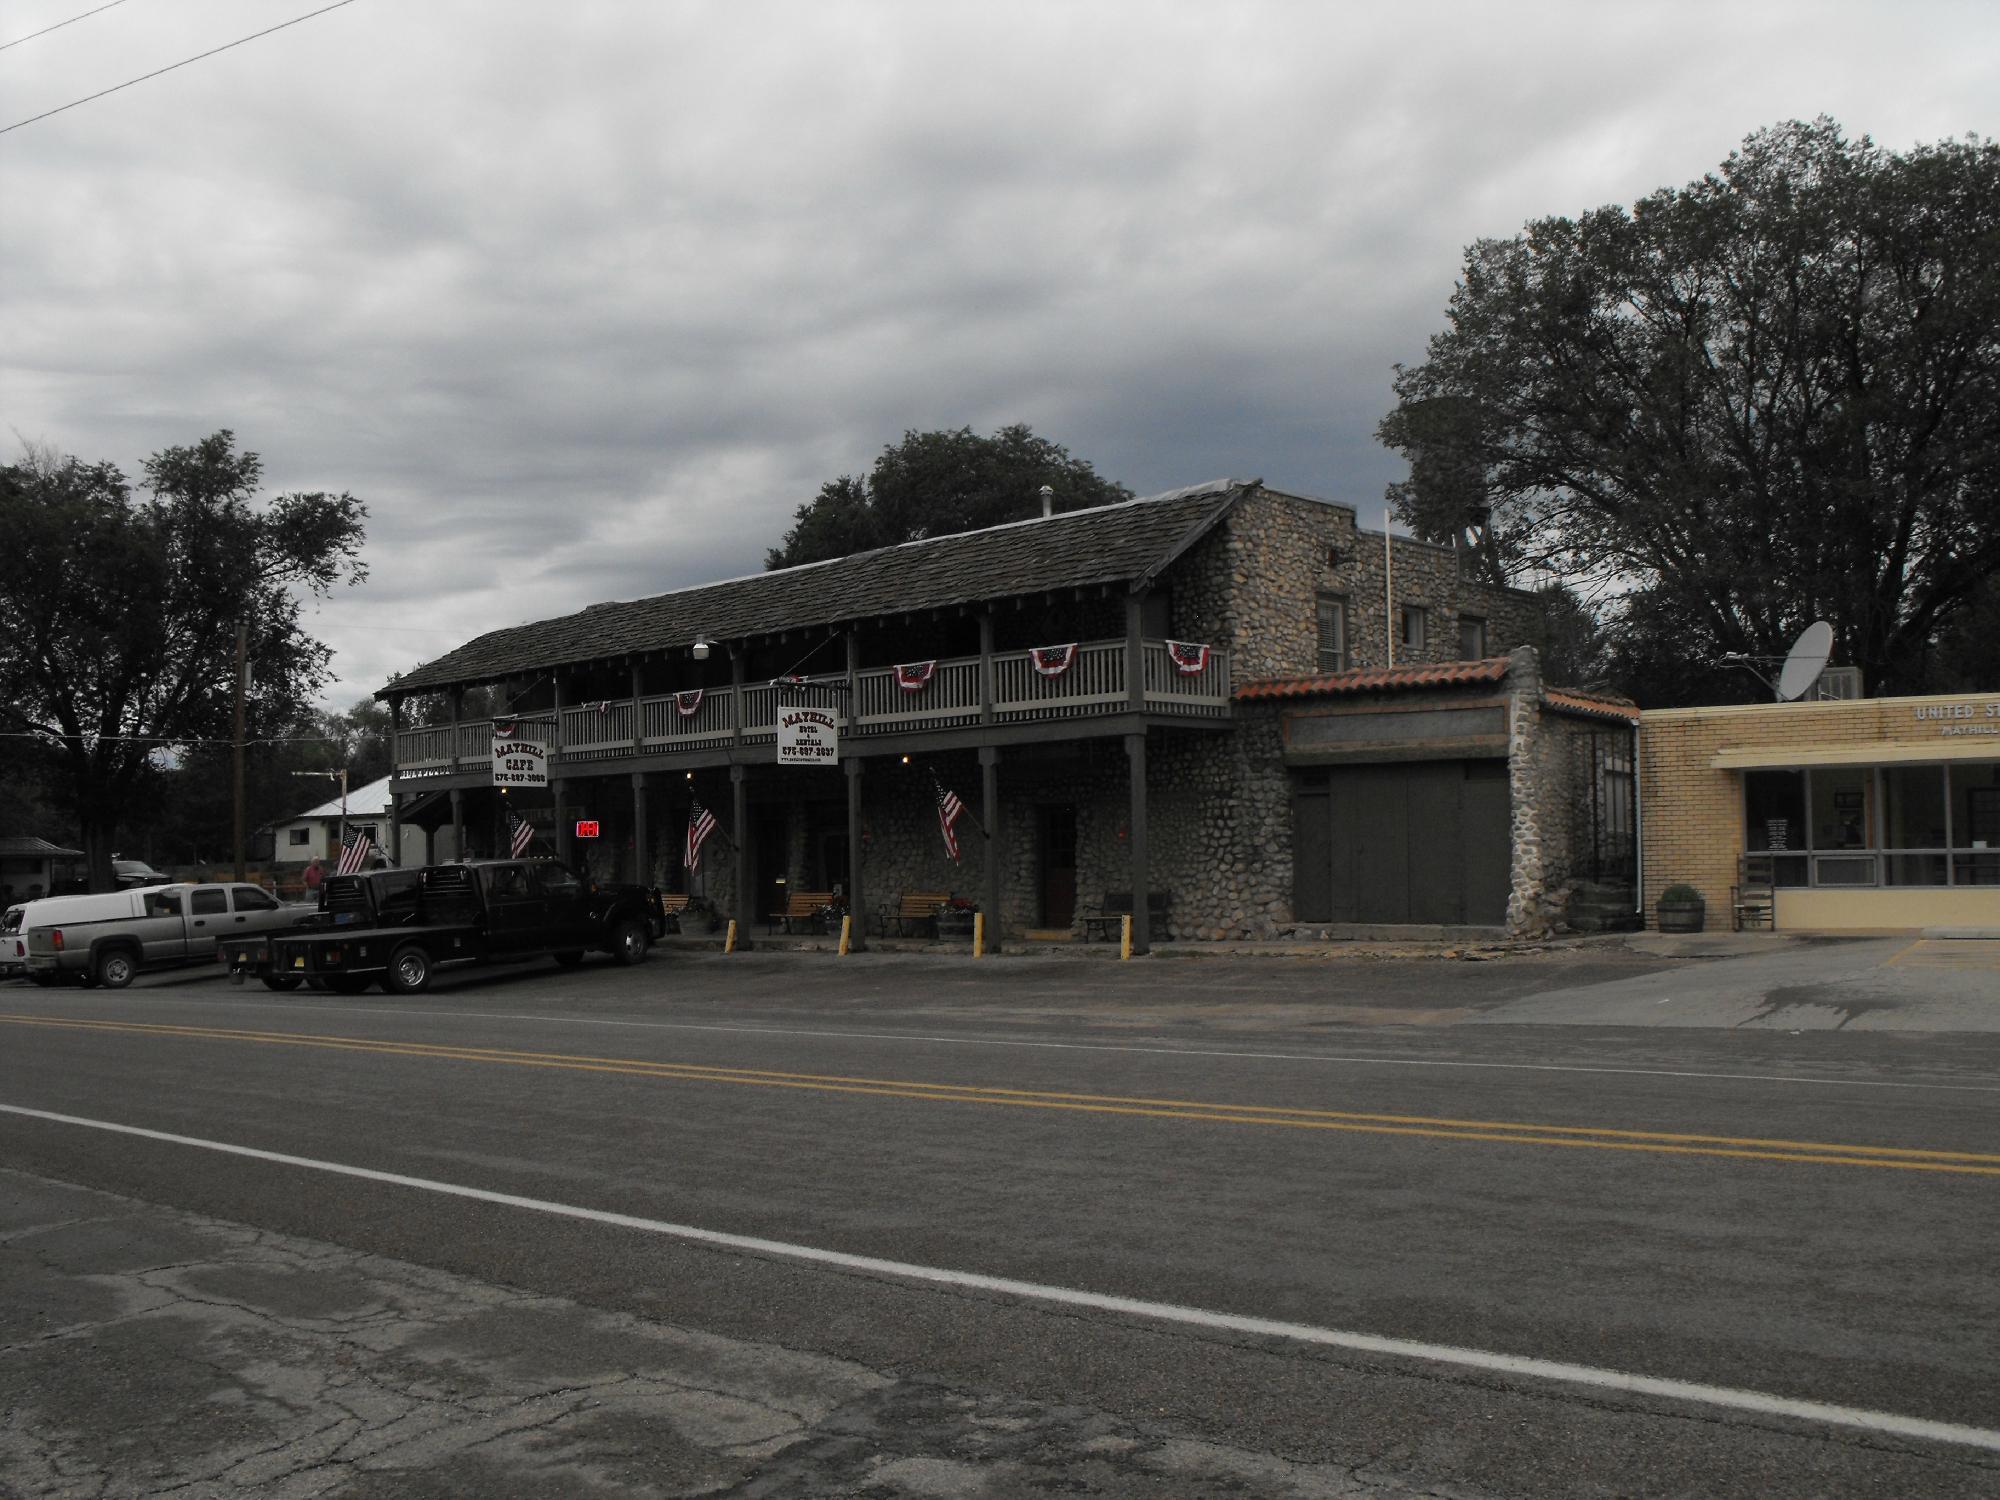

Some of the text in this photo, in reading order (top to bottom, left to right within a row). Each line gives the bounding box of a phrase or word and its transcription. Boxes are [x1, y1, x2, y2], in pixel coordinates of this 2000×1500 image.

[1915, 704, 1974, 720] UNITED
[782, 711, 834, 730] MAYHILL
[799, 725, 818, 733] HOTEL
[1941, 725, 1999, 736] MAYHILL
[495, 743, 544, 759] MAYHILL
[506, 759, 534, 771] CAFE
[577, 822, 597, 836] OPEN
